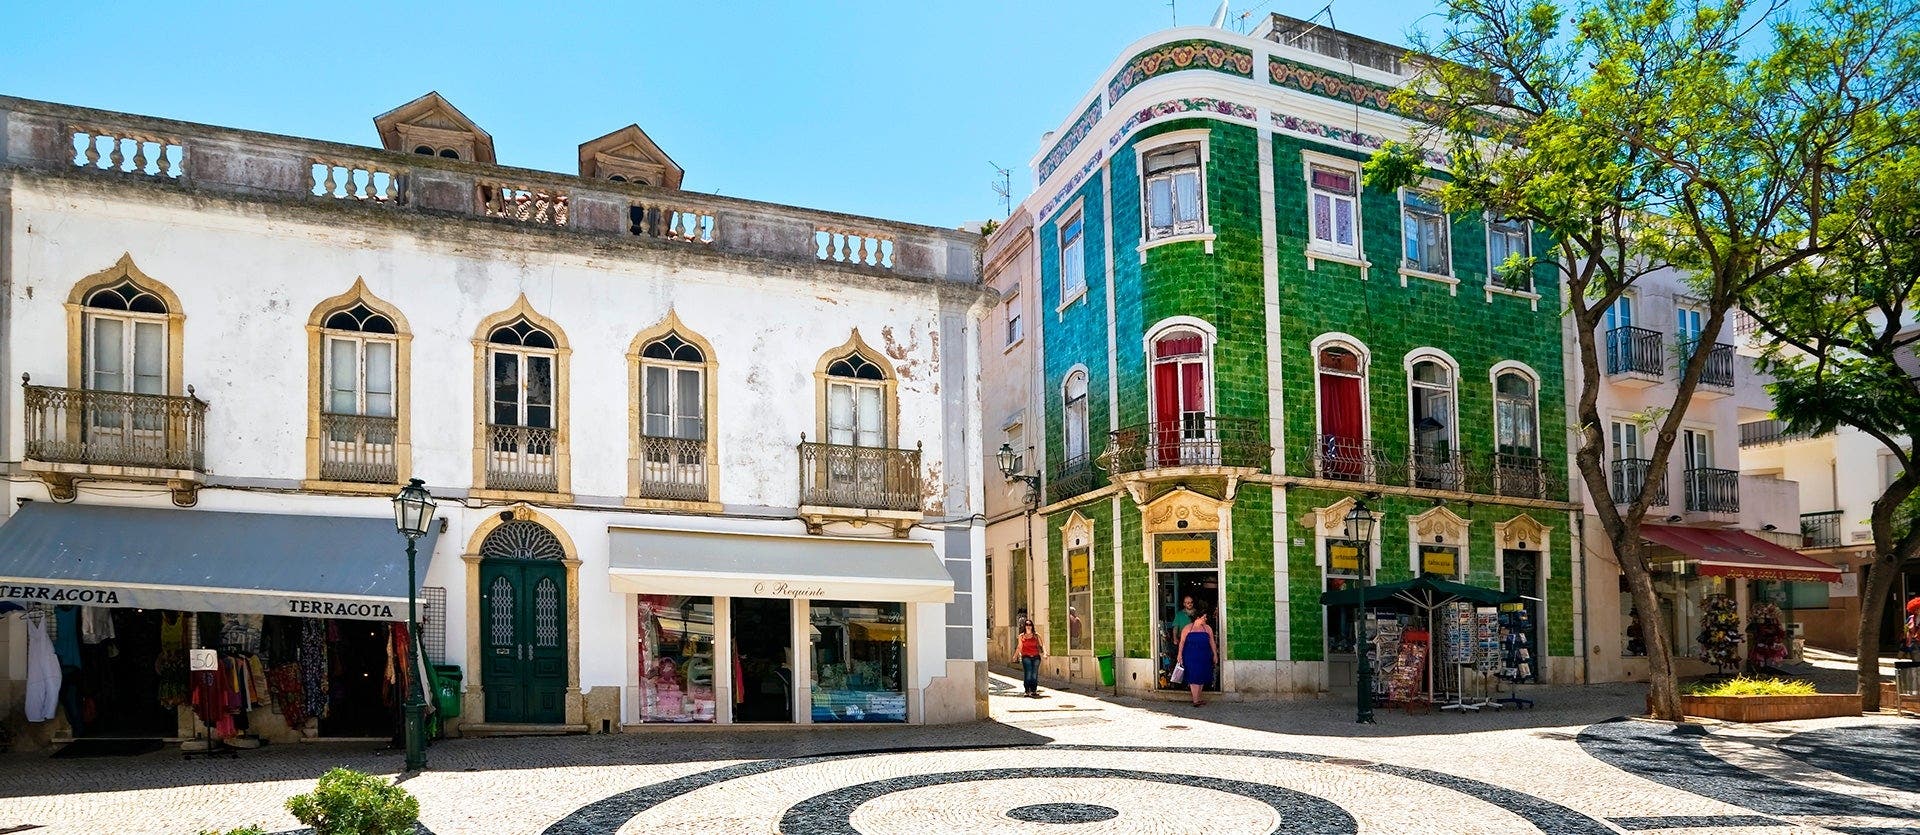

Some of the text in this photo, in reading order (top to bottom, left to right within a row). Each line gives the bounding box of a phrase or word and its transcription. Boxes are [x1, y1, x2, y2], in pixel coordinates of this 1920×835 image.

[511, 549, 532, 559] JLM
[0, 585, 119, 604] TERRACOTA
[753, 582, 825, 598] O Requinte
[289, 600, 393, 618] TERRACOTA
